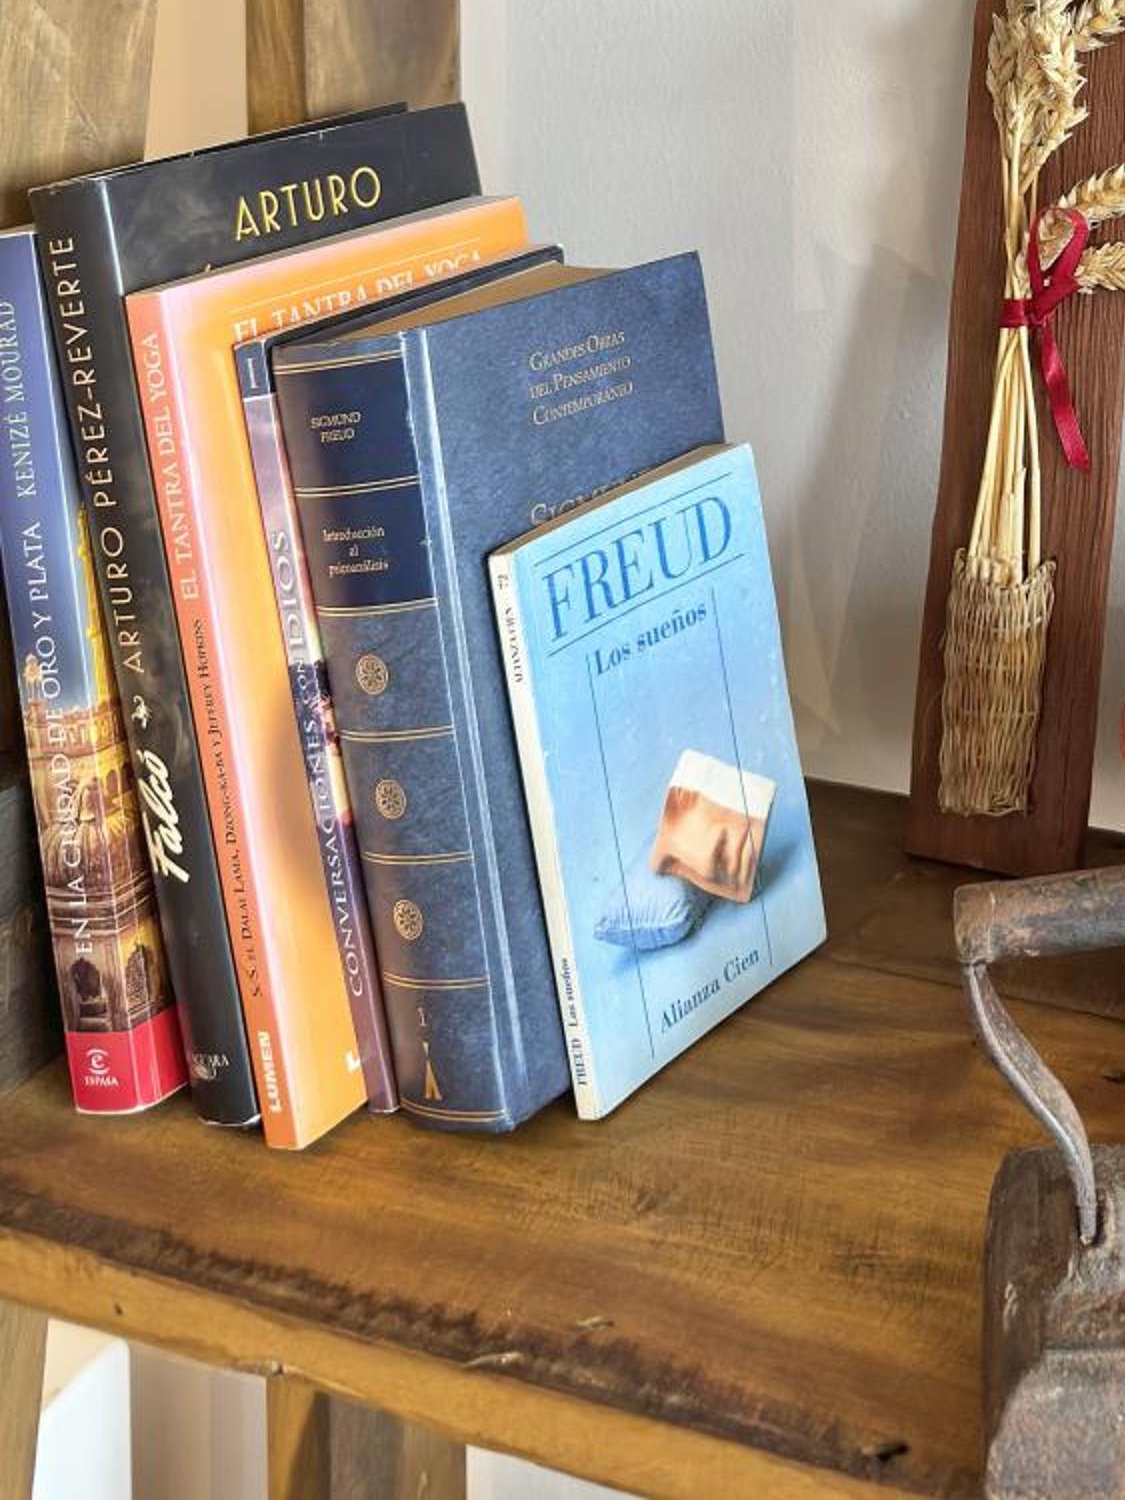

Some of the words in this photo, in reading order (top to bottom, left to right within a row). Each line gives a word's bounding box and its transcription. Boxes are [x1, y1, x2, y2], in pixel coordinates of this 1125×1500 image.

[235, 166, 381, 242] ARTURO
[0, 301, 25, 402] MOURAD
[50, 236, 117, 507] PÉREZ-REVERTE
[142, 332, 168, 402] YOGA
[4, 410, 37, 498] KENIZÉ
[154, 407, 176, 456] DEL
[164, 462, 193, 564] TANTRA
[22, 520, 49, 601] PLATA
[100, 526, 145, 674] ARTURO
[180, 569, 200, 601] EL
[272, 530, 305, 647] DIOS
[541, 496, 732, 643] FREUD
[32, 611, 51, 630] Y
[595, 642, 632, 676] Los
[637, 602, 707, 647] sueños
[35, 636, 61, 699] ORO
[46, 707, 67, 744] DE
[51, 754, 81, 868] CIUDAD
[138, 749, 191, 883] Falcó
[67, 876, 87, 907] LA
[305, 718, 364, 997] CONVERSACIONES
[71, 918, 93, 955] EN
[661, 978, 721, 1034] Alianza
[722, 949, 760, 984] Cien
[258, 1031, 282, 1114] LUMEN
